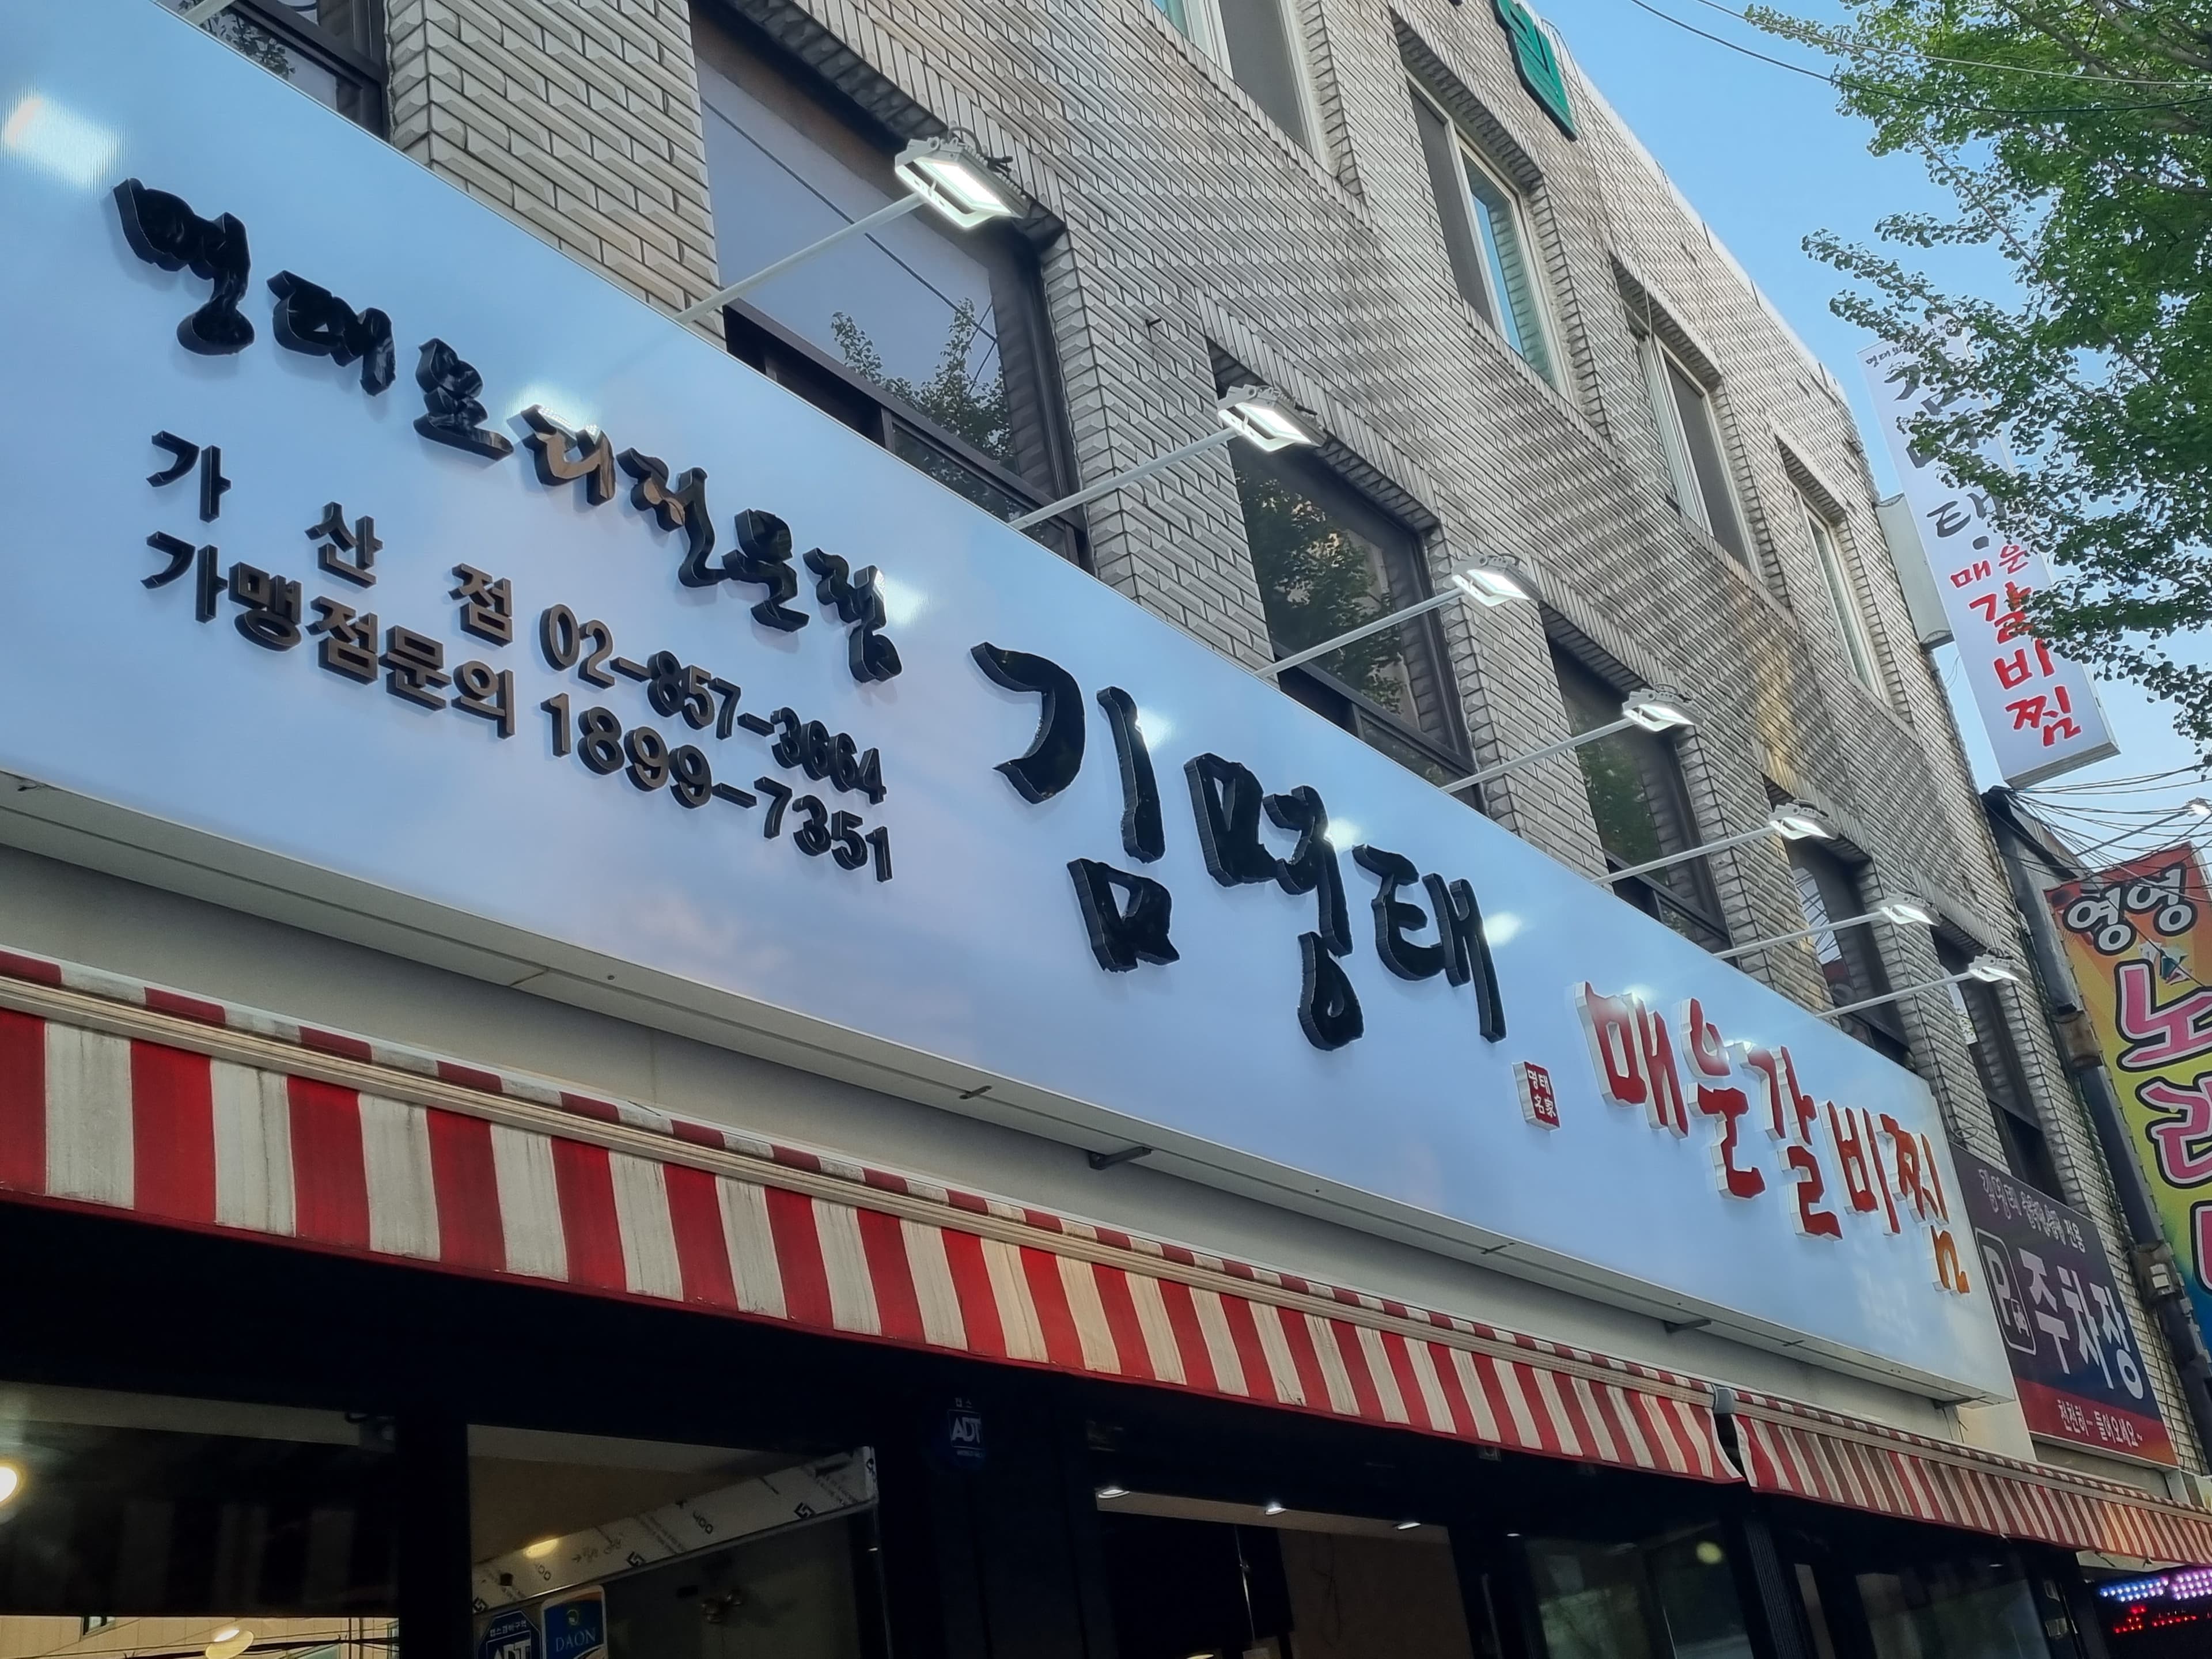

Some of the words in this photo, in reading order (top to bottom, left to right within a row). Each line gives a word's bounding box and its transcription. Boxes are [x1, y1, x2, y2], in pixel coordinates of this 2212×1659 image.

[1950, 545, 2029, 588] 매운
[141, 531, 516, 740] 가맹점문의
[540, 693, 893, 882] 1899-7351
[970, 641, 1507, 1051] 김명태
[1527, 1070, 1551, 1096] 명태
[2063, 1218, 2086, 1253] 전용
[2018, 1248, 2144, 1400] 주차장
[952, 1417, 981, 1444] ADT
[555, 1627, 597, 1652] DAON
